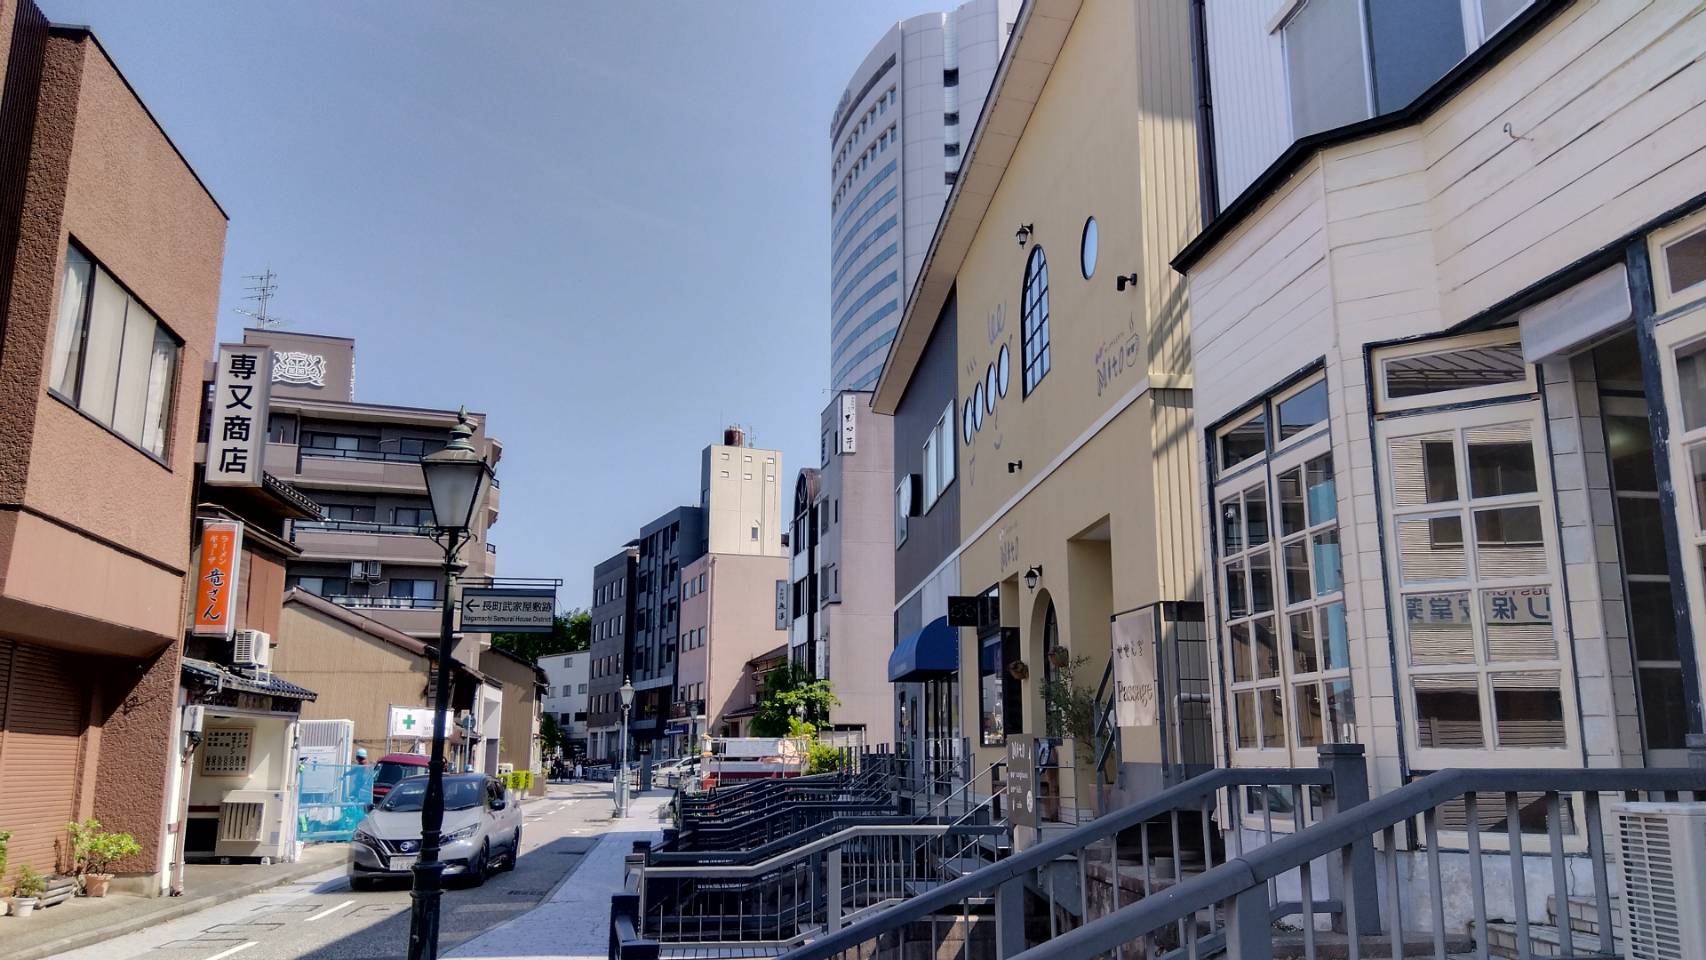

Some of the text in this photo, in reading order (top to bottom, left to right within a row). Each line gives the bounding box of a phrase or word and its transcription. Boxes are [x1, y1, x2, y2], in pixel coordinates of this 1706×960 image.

[219, 354, 257, 474] 専又商店
[482, 600, 553, 613] 長町武家屋敷跡
[463, 615, 492, 623] Nagamachi
[533, 615, 552, 623] District
[1117, 681, 1153, 707] Passage
